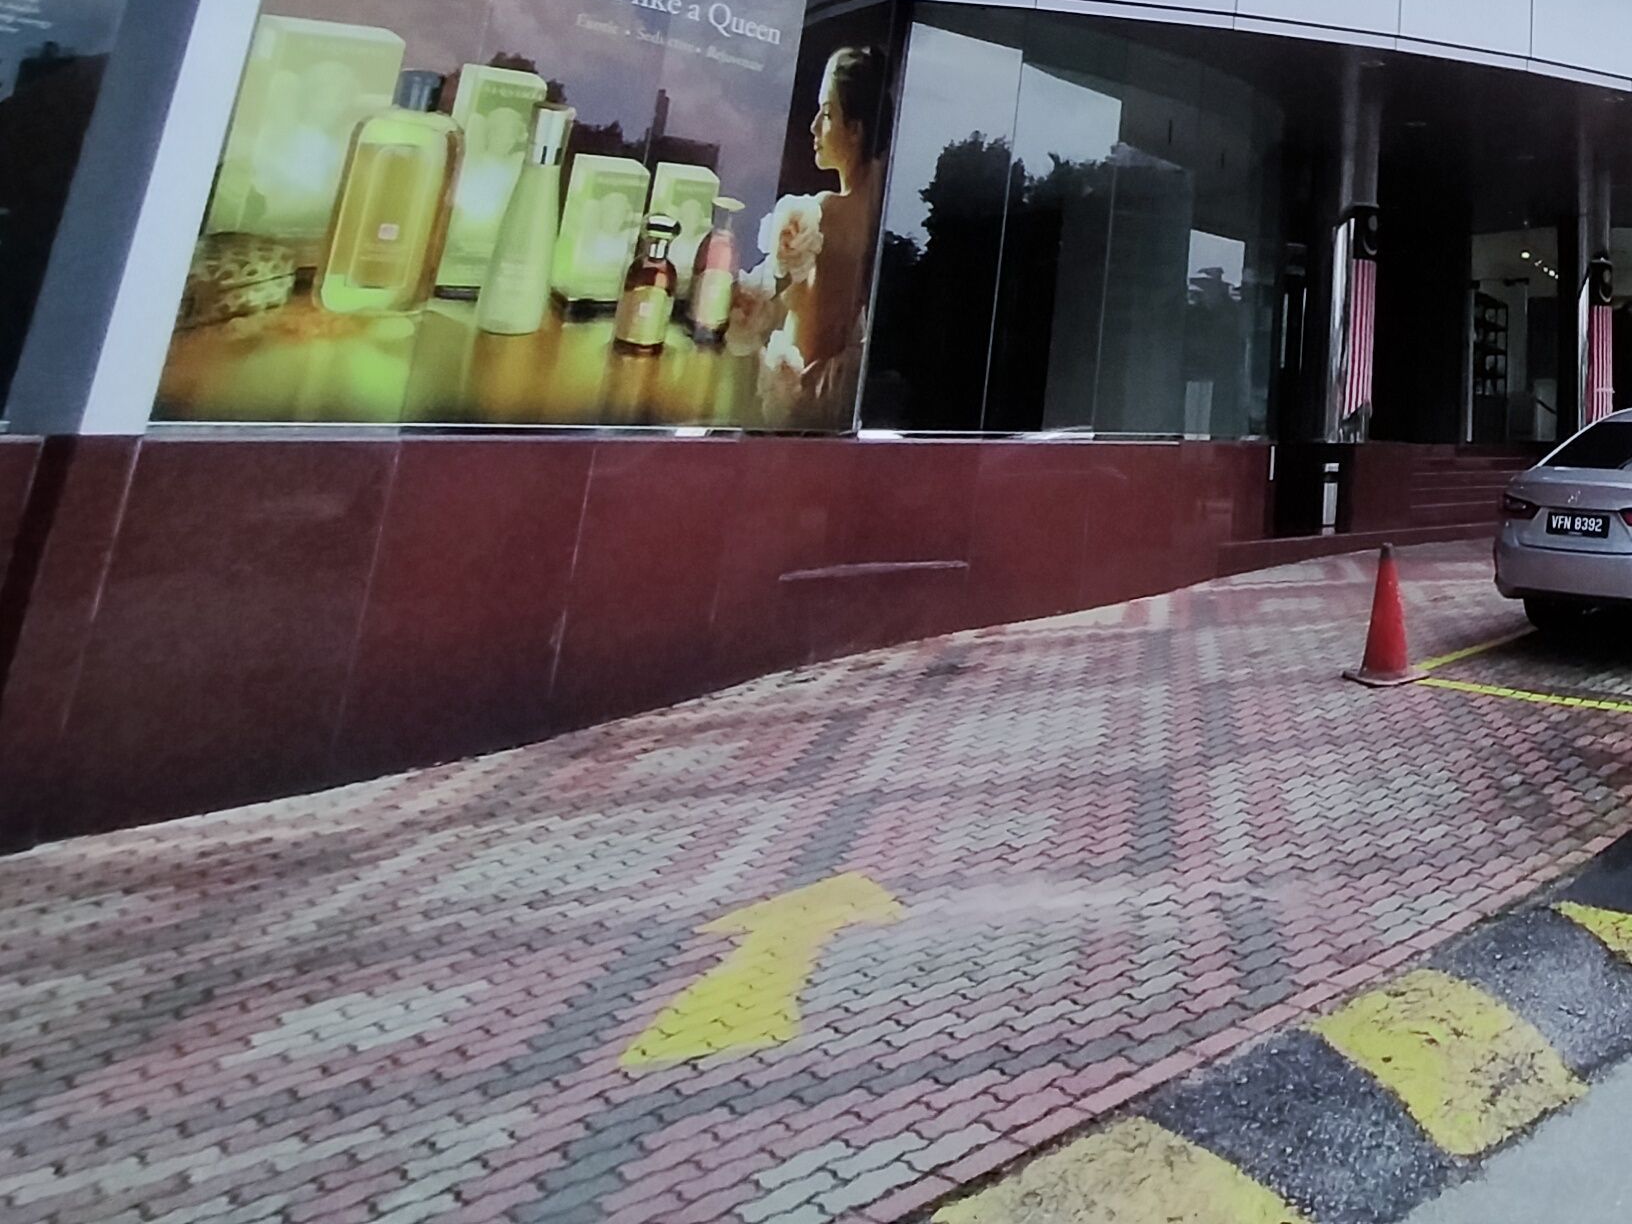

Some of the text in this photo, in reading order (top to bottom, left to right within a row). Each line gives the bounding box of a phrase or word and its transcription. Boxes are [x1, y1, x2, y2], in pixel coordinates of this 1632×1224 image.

[687, 4, 700, 22] a
[708, 3, 781, 45] Queen
[1552, 515, 1571, 530] VFN
